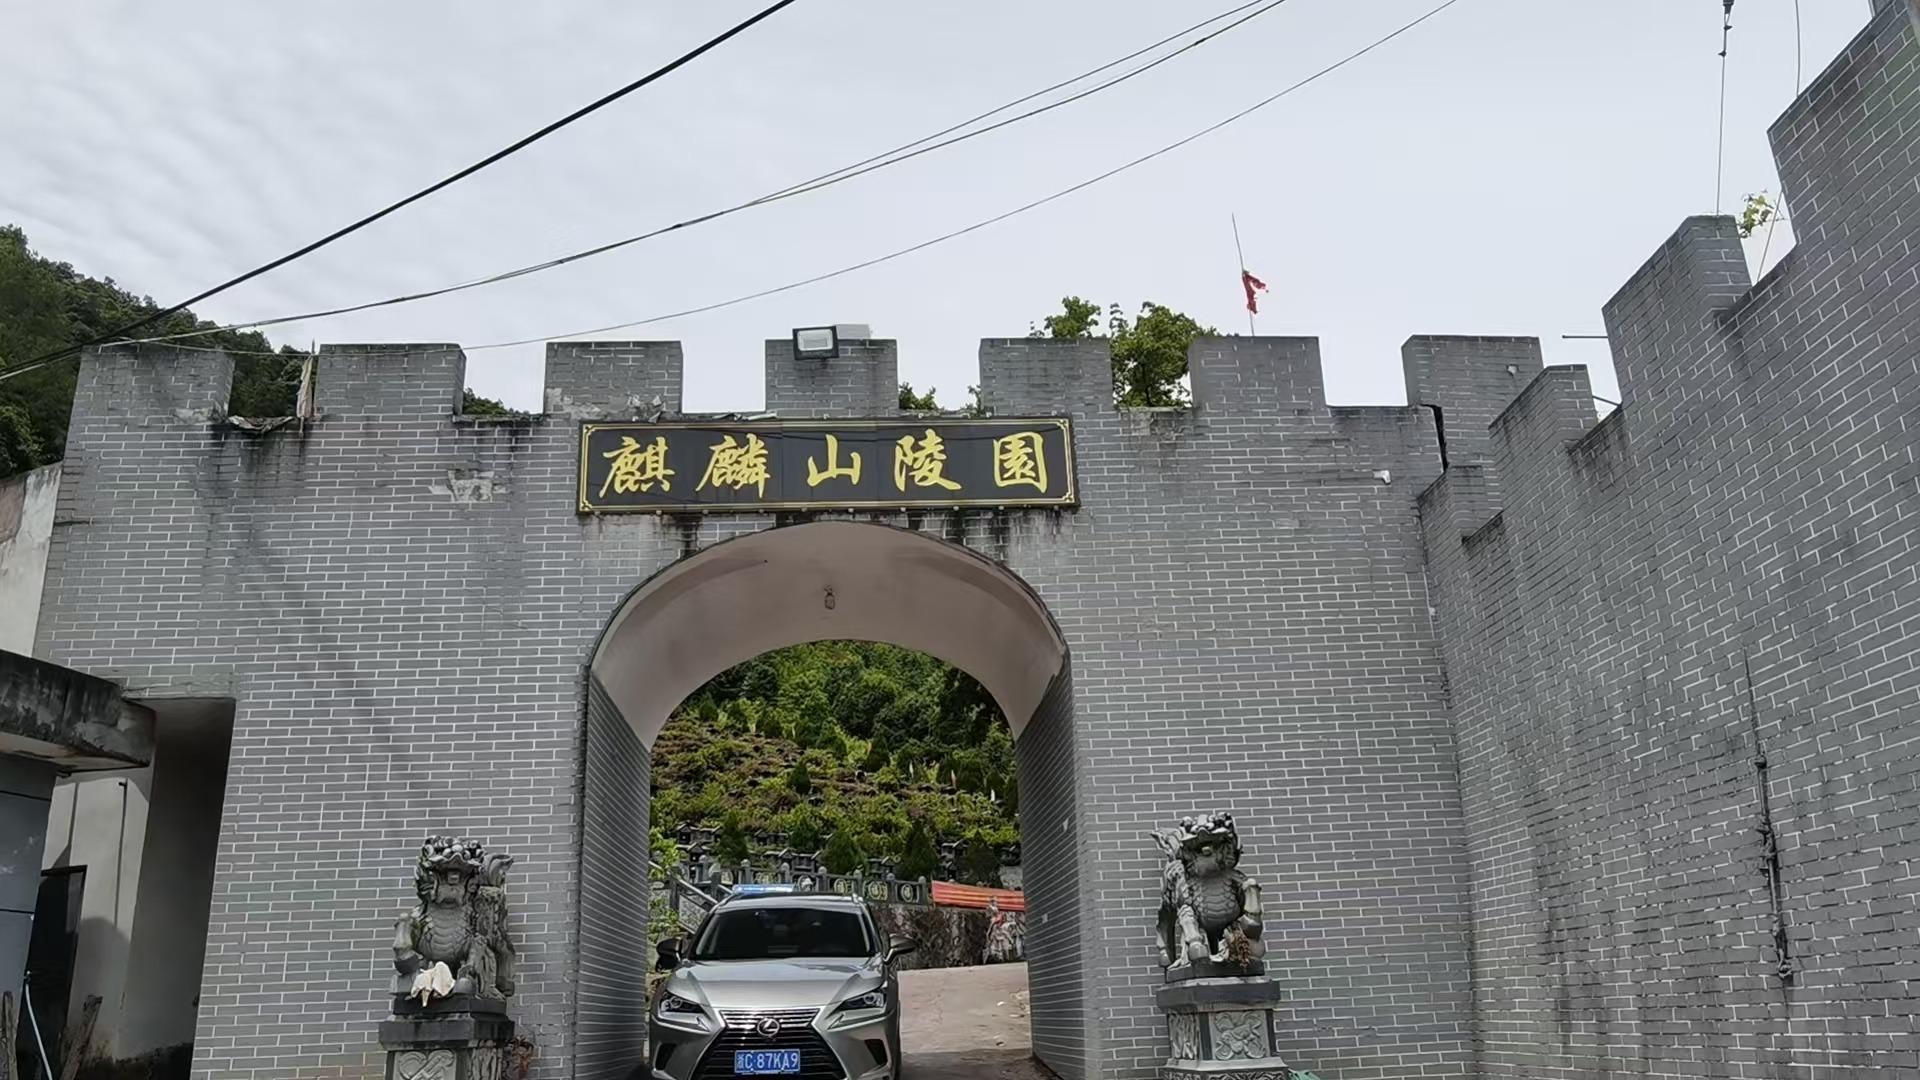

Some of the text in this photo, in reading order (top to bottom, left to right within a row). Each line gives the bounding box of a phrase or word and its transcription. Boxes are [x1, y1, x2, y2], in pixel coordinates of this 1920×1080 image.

[599, 428, 1047, 498] 麒麟山陵園
